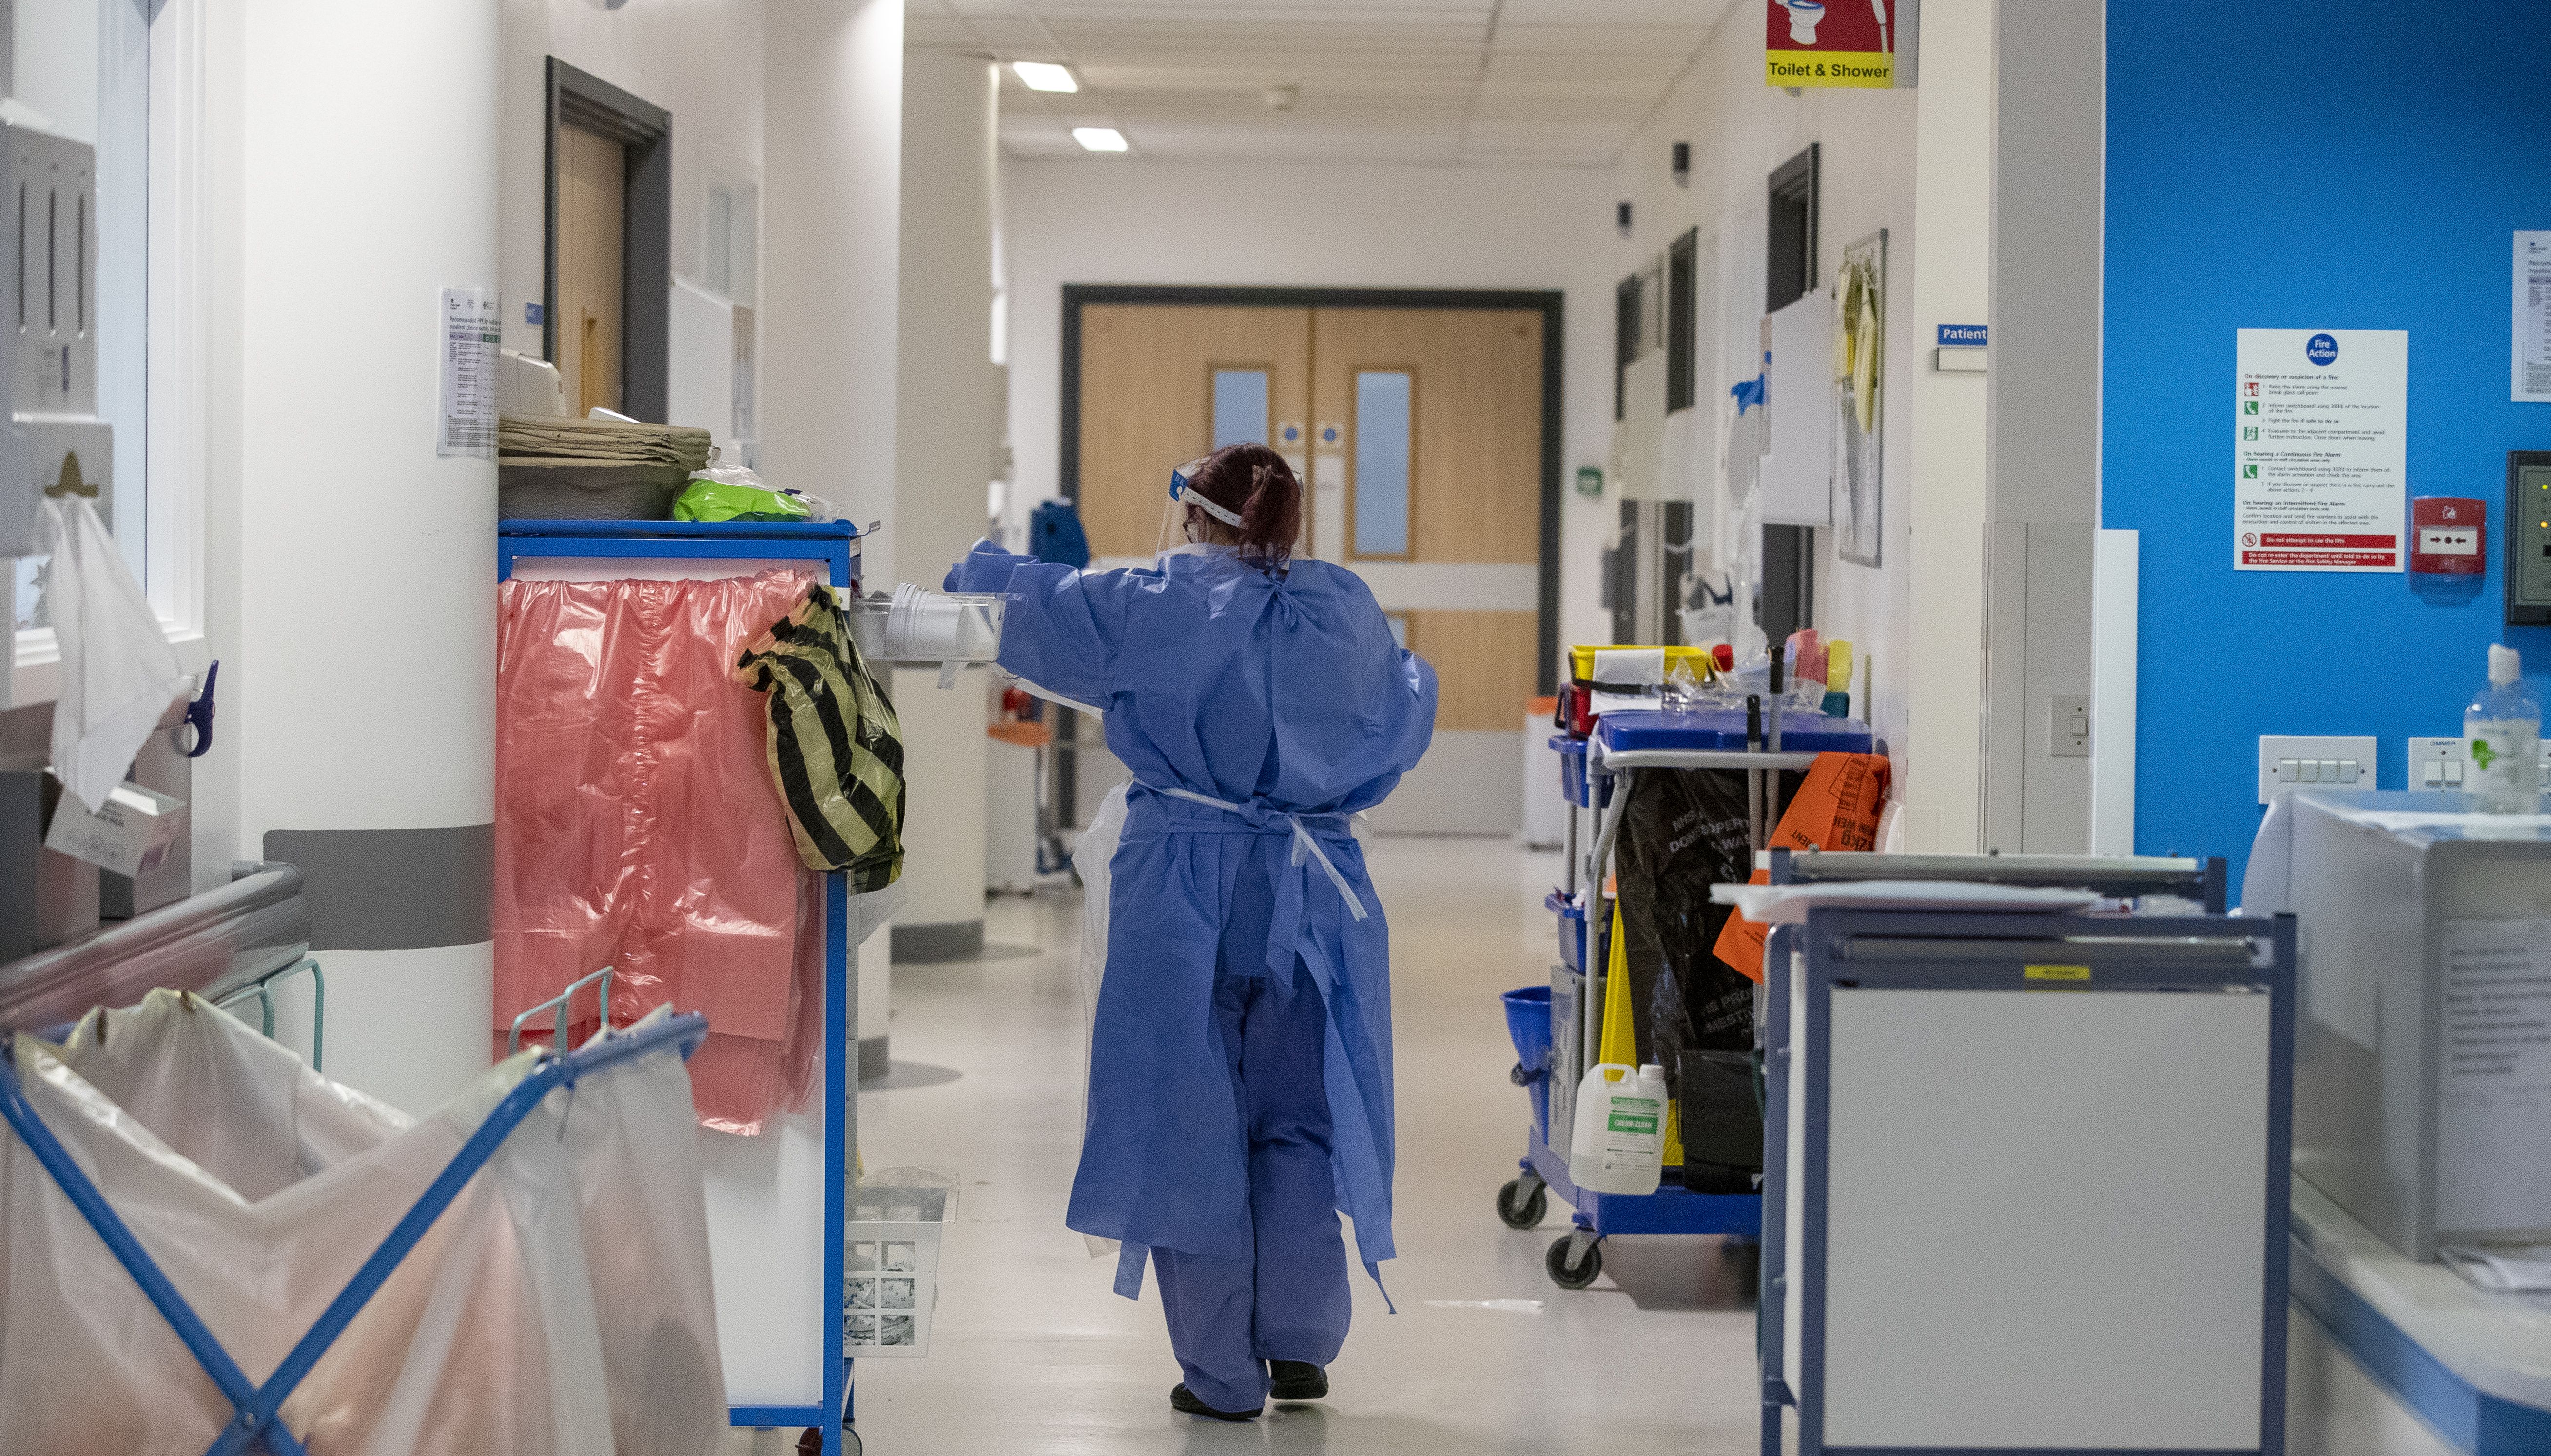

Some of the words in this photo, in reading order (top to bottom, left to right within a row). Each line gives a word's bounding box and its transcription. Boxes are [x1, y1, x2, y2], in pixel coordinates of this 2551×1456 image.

[1769, 63, 1810, 76] Toilet
[1815, 64, 1826, 77] &
[1831, 64, 1889, 78] Shower
[1943, 328, 1986, 339] Patient
[2315, 340, 2330, 349] Fire
[2308, 349, 2336, 358] Action
